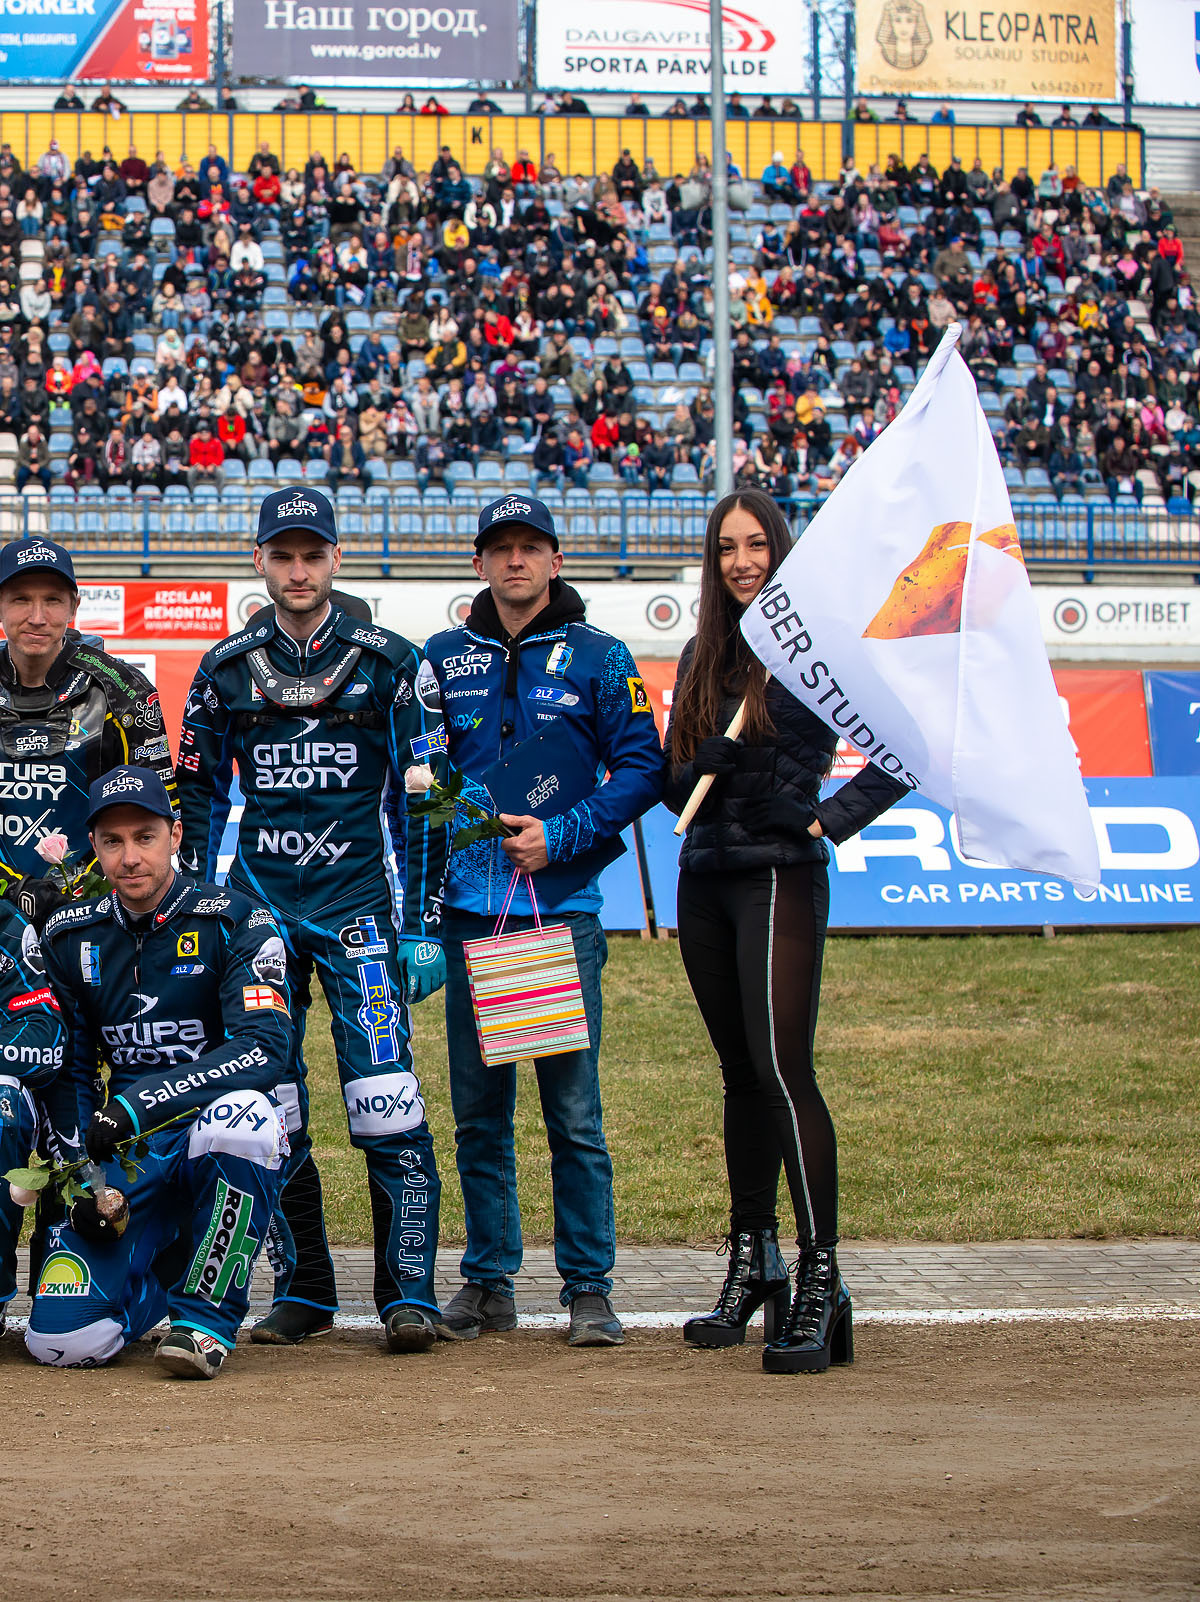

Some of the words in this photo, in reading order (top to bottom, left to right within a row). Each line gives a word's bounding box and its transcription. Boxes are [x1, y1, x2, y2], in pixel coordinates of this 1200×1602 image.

[264, 0, 354, 31] Наш
[367, 8, 488, 38] город.
[945, 11, 1099, 45] KLEOPATRA
[310, 43, 442, 61] www.gorod.lv
[1032, 48, 1090, 64] STUDIJA
[564, 57, 648, 73] SPORTA
[470, 126, 483, 144] K
[79, 588, 121, 601] PUFAS
[144, 606, 223, 620] REMONTAM
[1096, 602, 1191, 623] OPTIBET
[215, 632, 253, 656] CHEMART
[252, 651, 273, 678] CHEMART
[759, 572, 813, 664] MBER
[799, 661, 922, 791] STUDIOS
[444, 687, 489, 700] Saletromag
[535, 687, 554, 699] 2LŻ
[881, 884, 951, 904] CAR
[958, 881, 1065, 903] PARTS
[1072, 883, 1194, 904] ONLINE
[46, 905, 92, 930] HEMART
[346, 948, 367, 958] dasta
[367, 945, 388, 954] invest
[368, 984, 386, 1045] REALL
[138, 1046, 269, 1110] Saletromag
[208, 1186, 243, 1266] ROCK
[398, 1172, 429, 1281] DELICJA
[39, 1281, 89, 1296] OZKWIT
